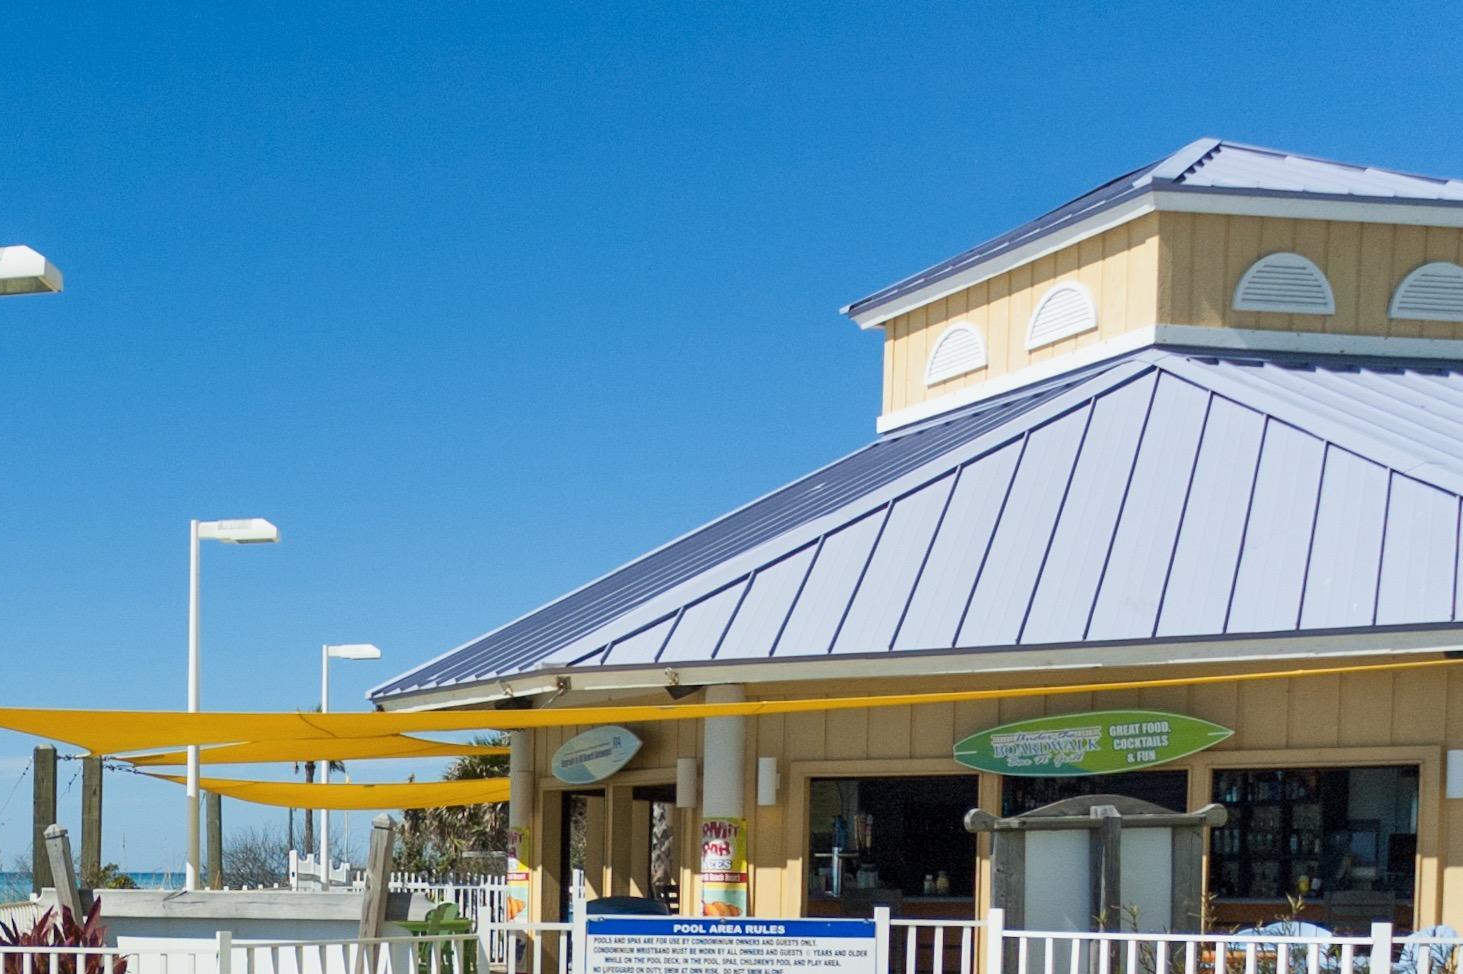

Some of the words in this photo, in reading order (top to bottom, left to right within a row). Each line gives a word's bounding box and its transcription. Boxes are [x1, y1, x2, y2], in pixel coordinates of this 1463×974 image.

[1109, 723, 1140, 737] GREAT
[1113, 735, 1168, 750] COCKTAILS
[1127, 753, 1135, 763] &
[1137, 750, 1156, 762] FUN
[673, 924, 707, 934] POOL
[709, 924, 742, 934] AREA
[745, 925, 786, 935] RULES
